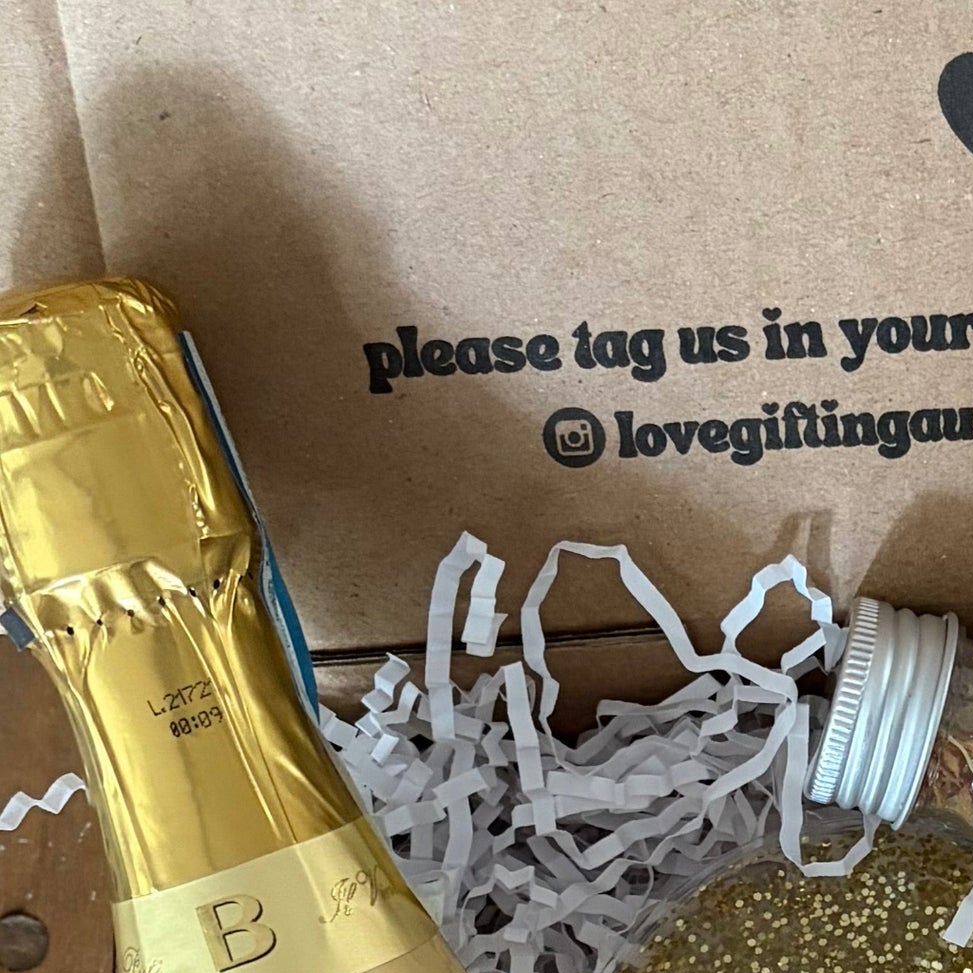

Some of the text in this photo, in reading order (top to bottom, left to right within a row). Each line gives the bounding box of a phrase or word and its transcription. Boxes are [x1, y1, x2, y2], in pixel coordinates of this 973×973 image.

[363, 325, 562, 394] please
[572, 321, 666, 383] tag
[679, 324, 751, 365] us
[762, 307, 827, 360] in
[195, 894, 278, 973] B
